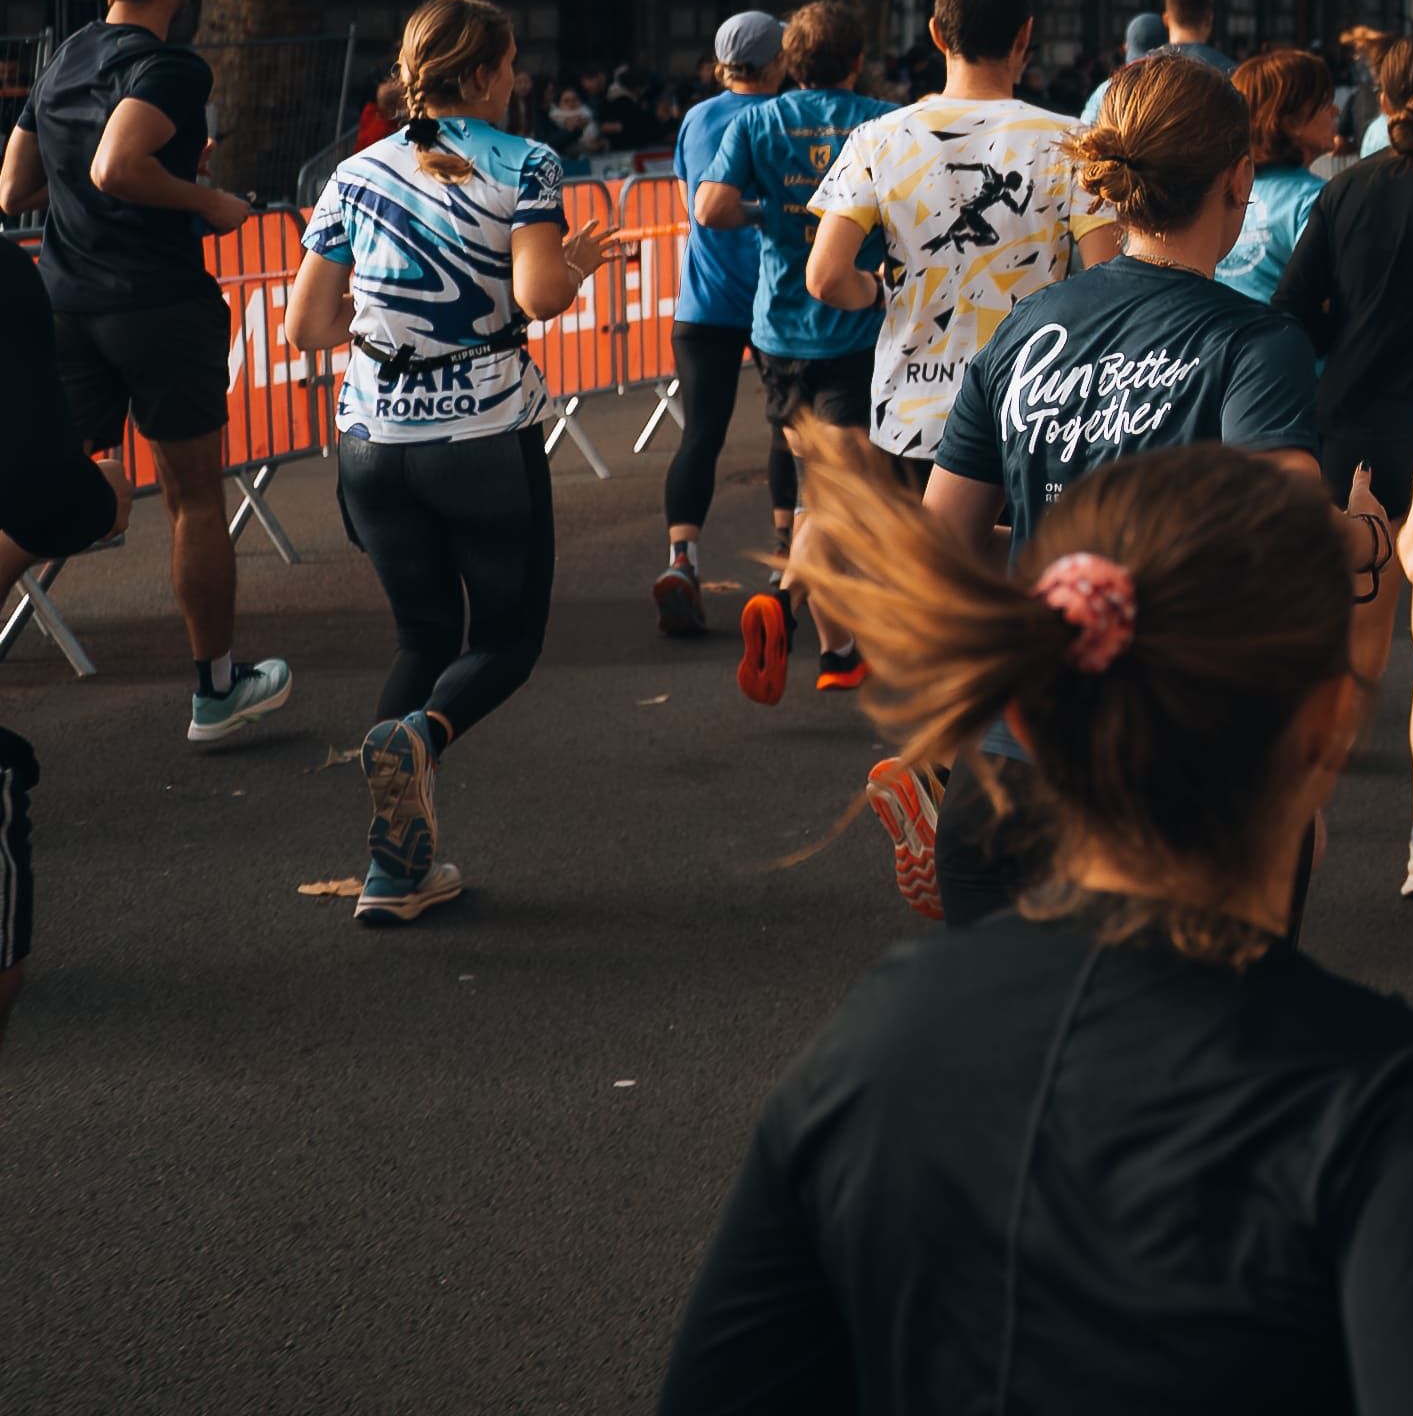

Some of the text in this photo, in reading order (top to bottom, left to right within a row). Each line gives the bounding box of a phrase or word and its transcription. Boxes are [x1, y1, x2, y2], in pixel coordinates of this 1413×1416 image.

[375, 394, 480, 418] RONCQ
[1000, 322, 1200, 442] Run Better
[1026, 388, 1172, 464] Together
[1045, 483, 1063, 493] ON
